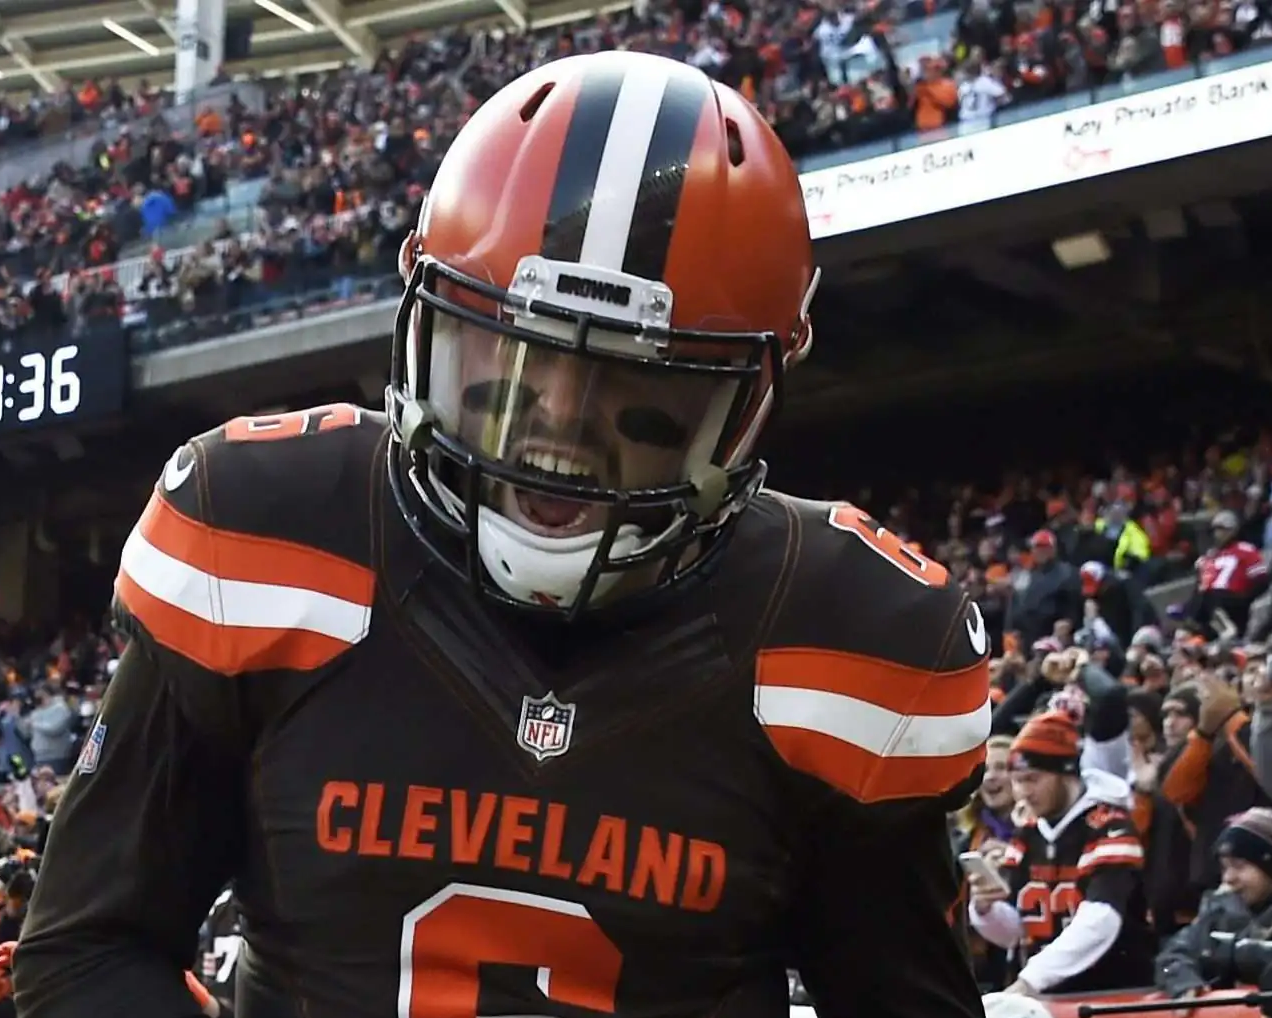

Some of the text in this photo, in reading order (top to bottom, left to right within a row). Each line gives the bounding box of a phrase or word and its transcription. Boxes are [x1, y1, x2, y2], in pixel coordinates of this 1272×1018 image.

[556, 272, 632, 307] BROWNS
[526, 720, 563, 749] NFL
[315, 779, 728, 913] CLEVELAND
